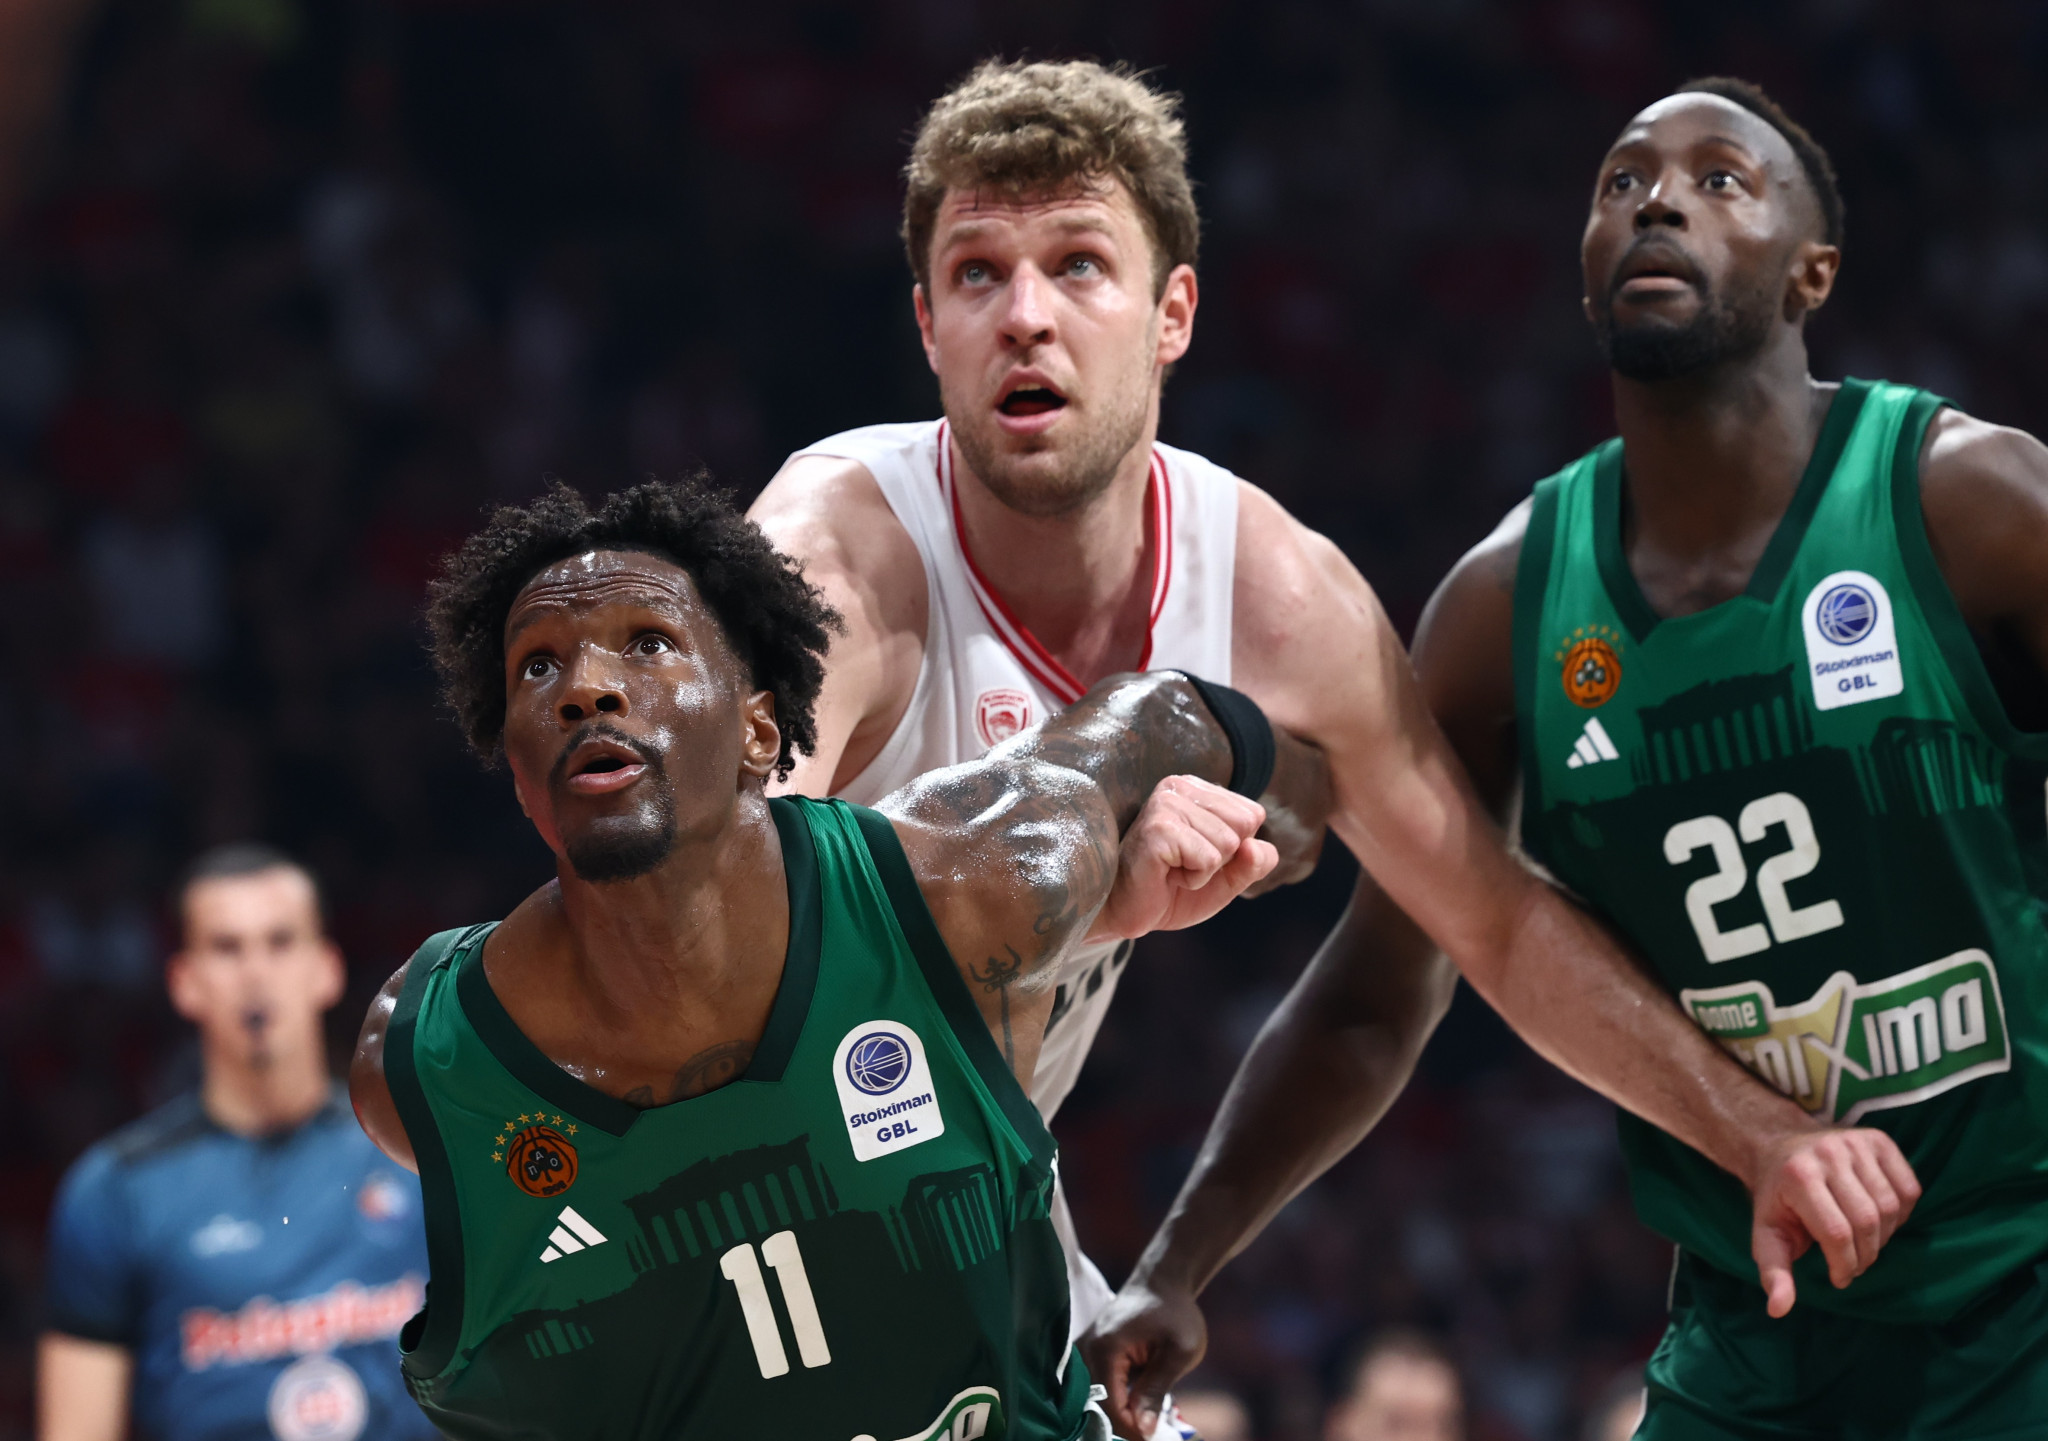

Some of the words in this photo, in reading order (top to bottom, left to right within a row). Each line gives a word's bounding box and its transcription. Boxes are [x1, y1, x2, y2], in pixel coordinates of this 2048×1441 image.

[1837, 673, 1878, 692] GBL
[1663, 791, 1845, 965] 22
[850, 1092, 933, 1129] Stoiximan
[877, 1119, 918, 1143] GBL
[719, 1230, 832, 1379] 11
